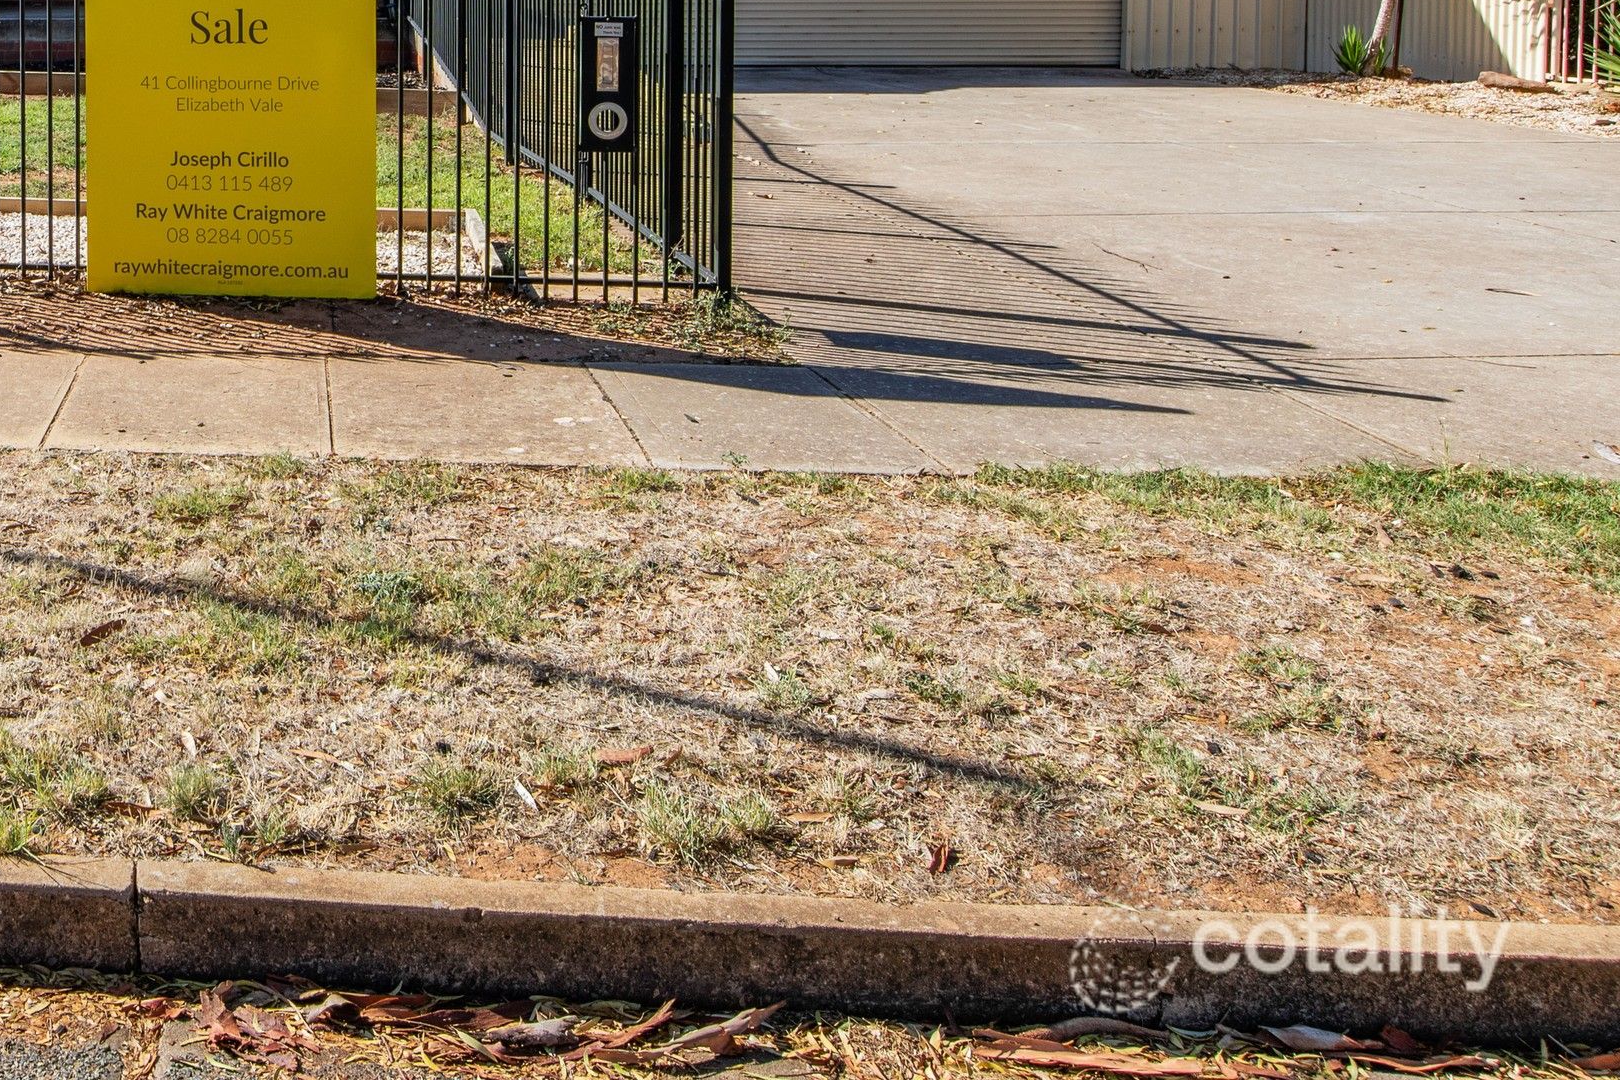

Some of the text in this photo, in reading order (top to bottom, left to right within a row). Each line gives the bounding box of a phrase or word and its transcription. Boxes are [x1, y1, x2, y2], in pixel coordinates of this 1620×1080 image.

[190, 9, 269, 45] Sale
[140, 75, 320, 94] 41 Collingbourne Drive
[177, 97, 284, 113] Elizabeth Vale
[170, 151, 290, 171] Joseph Cirillo
[166, 175, 294, 193] 0413 115 489
[136, 203, 326, 225] Ray White Craigmore
[166, 227, 294, 246] 08 8284 0055
[114, 258, 349, 281] raywhitecraigmore.com.au
